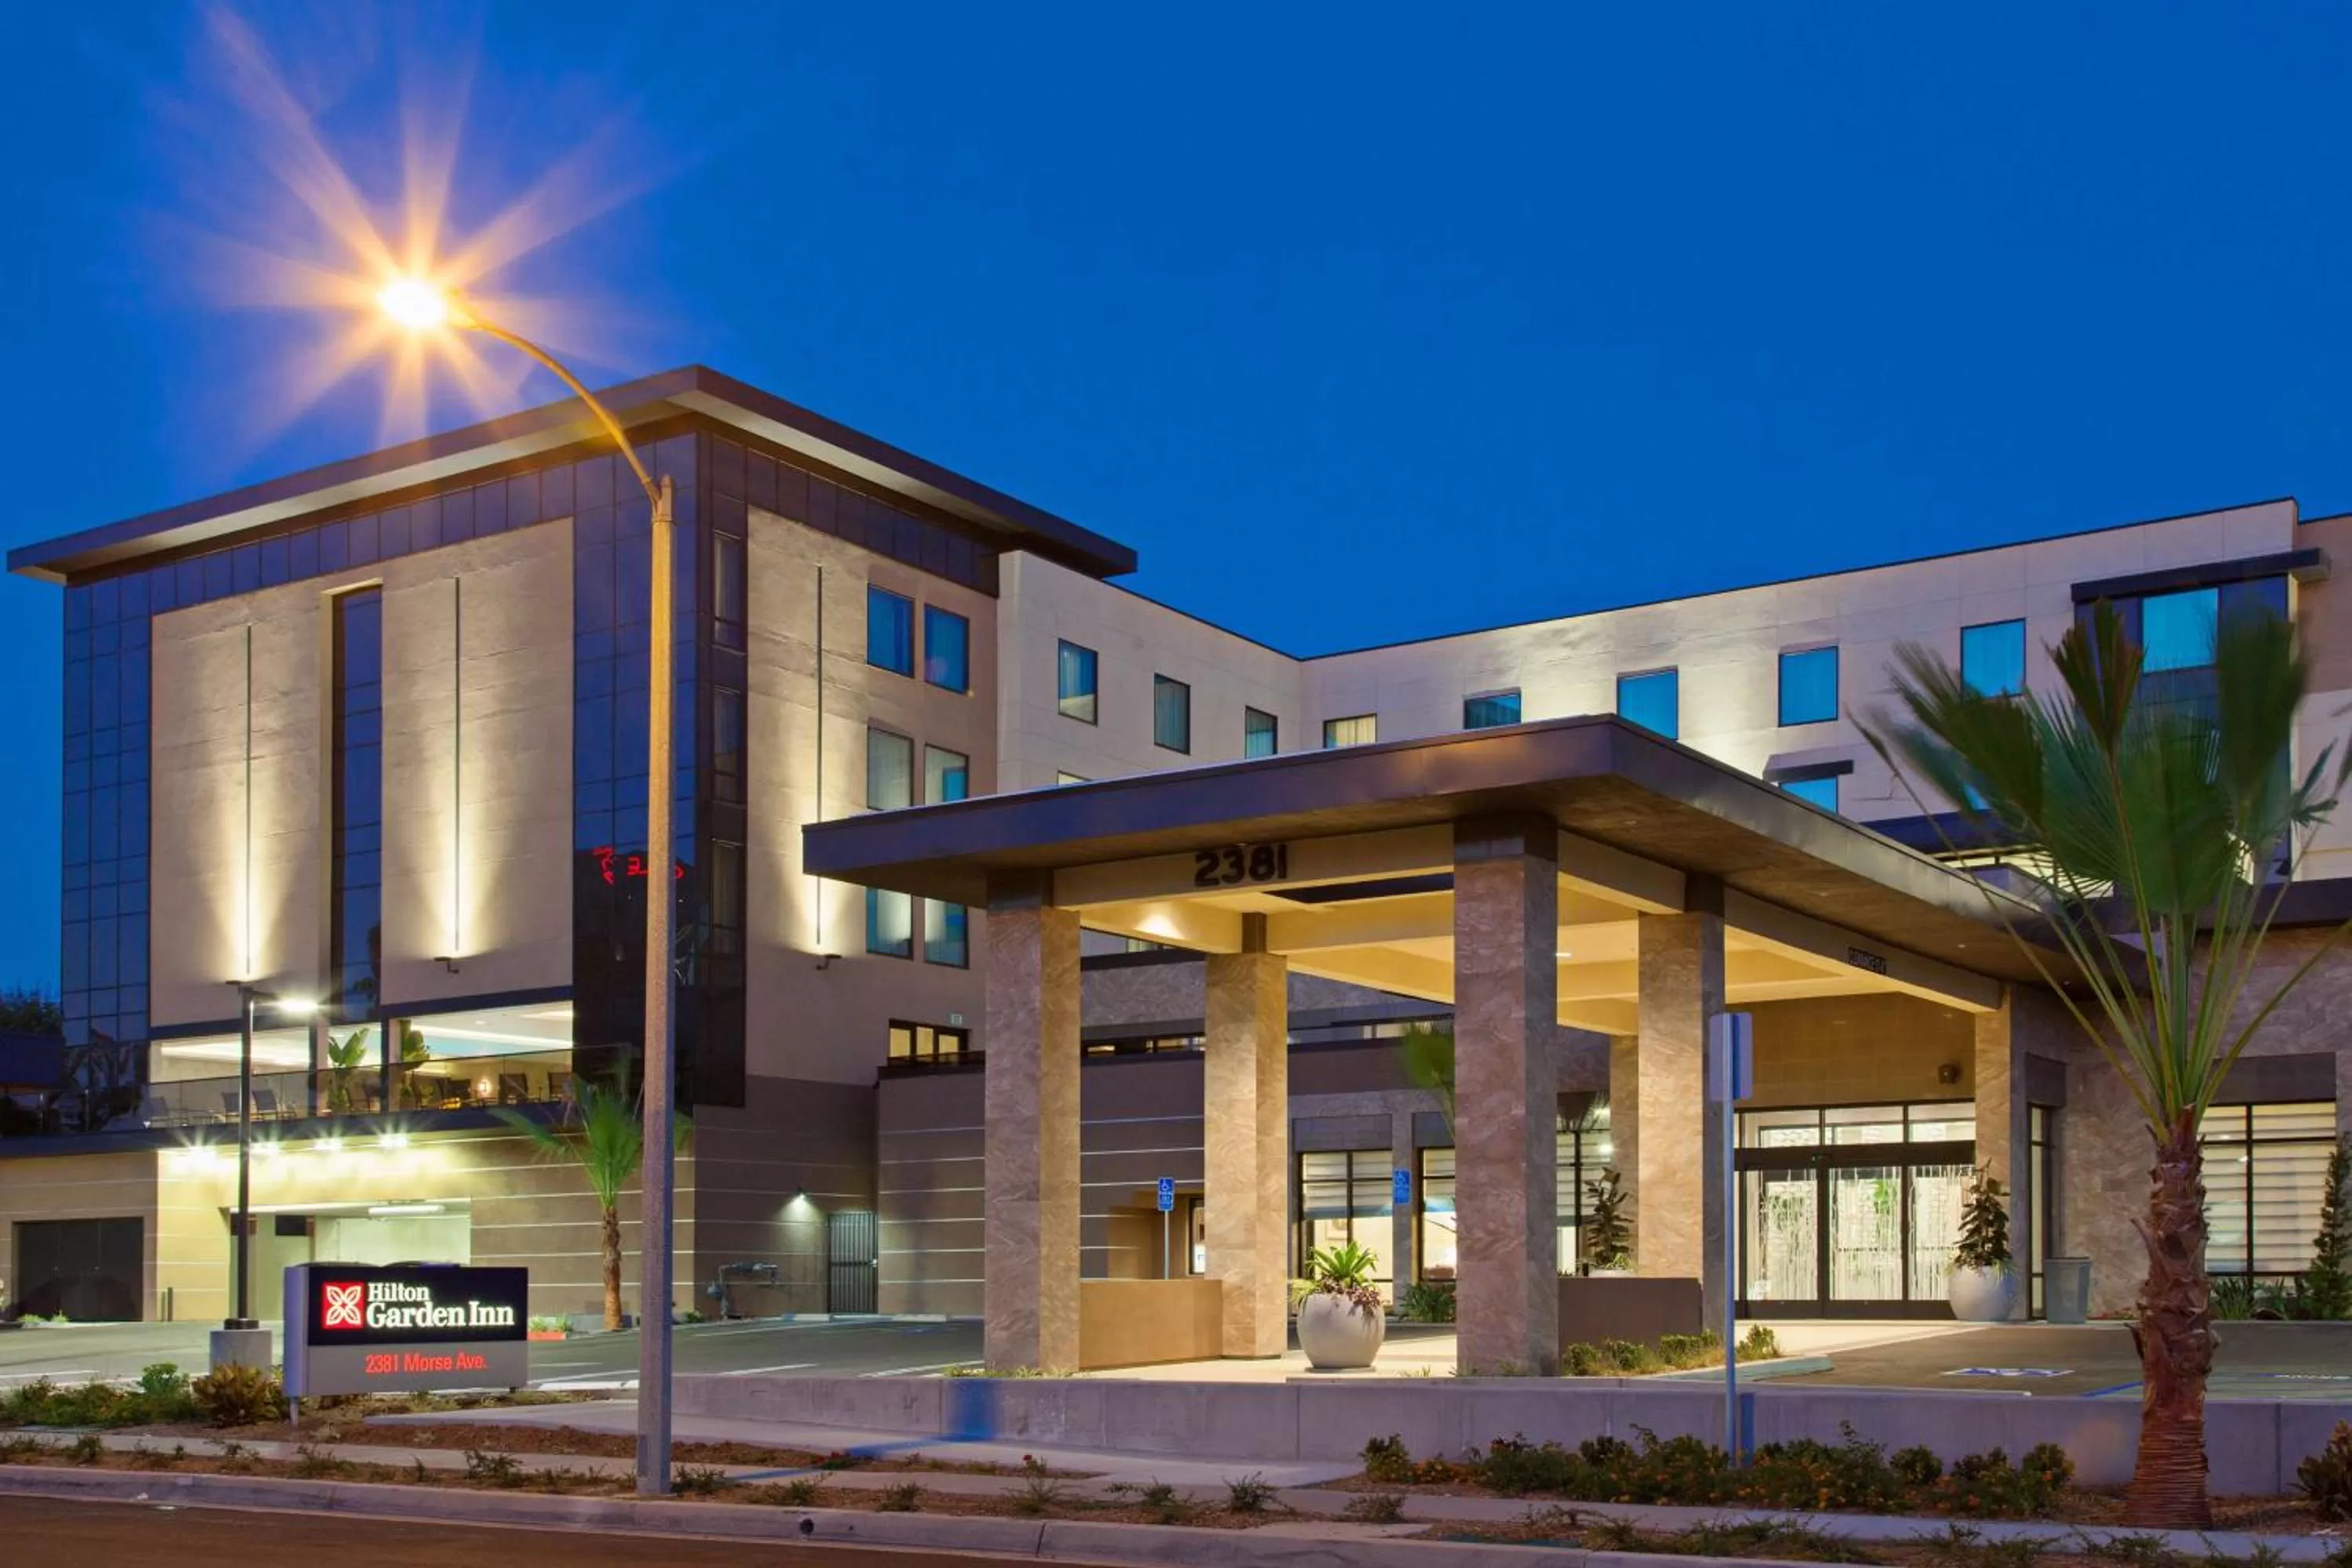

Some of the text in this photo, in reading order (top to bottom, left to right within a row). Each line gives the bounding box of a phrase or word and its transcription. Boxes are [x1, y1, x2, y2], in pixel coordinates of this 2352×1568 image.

[1194, 844, 1288, 887] 2381
[367, 1282, 430, 1302] Hilton
[366, 1301, 515, 1328] Garden Inn
[365, 1351, 488, 1374] 2381 Morse Ave.
